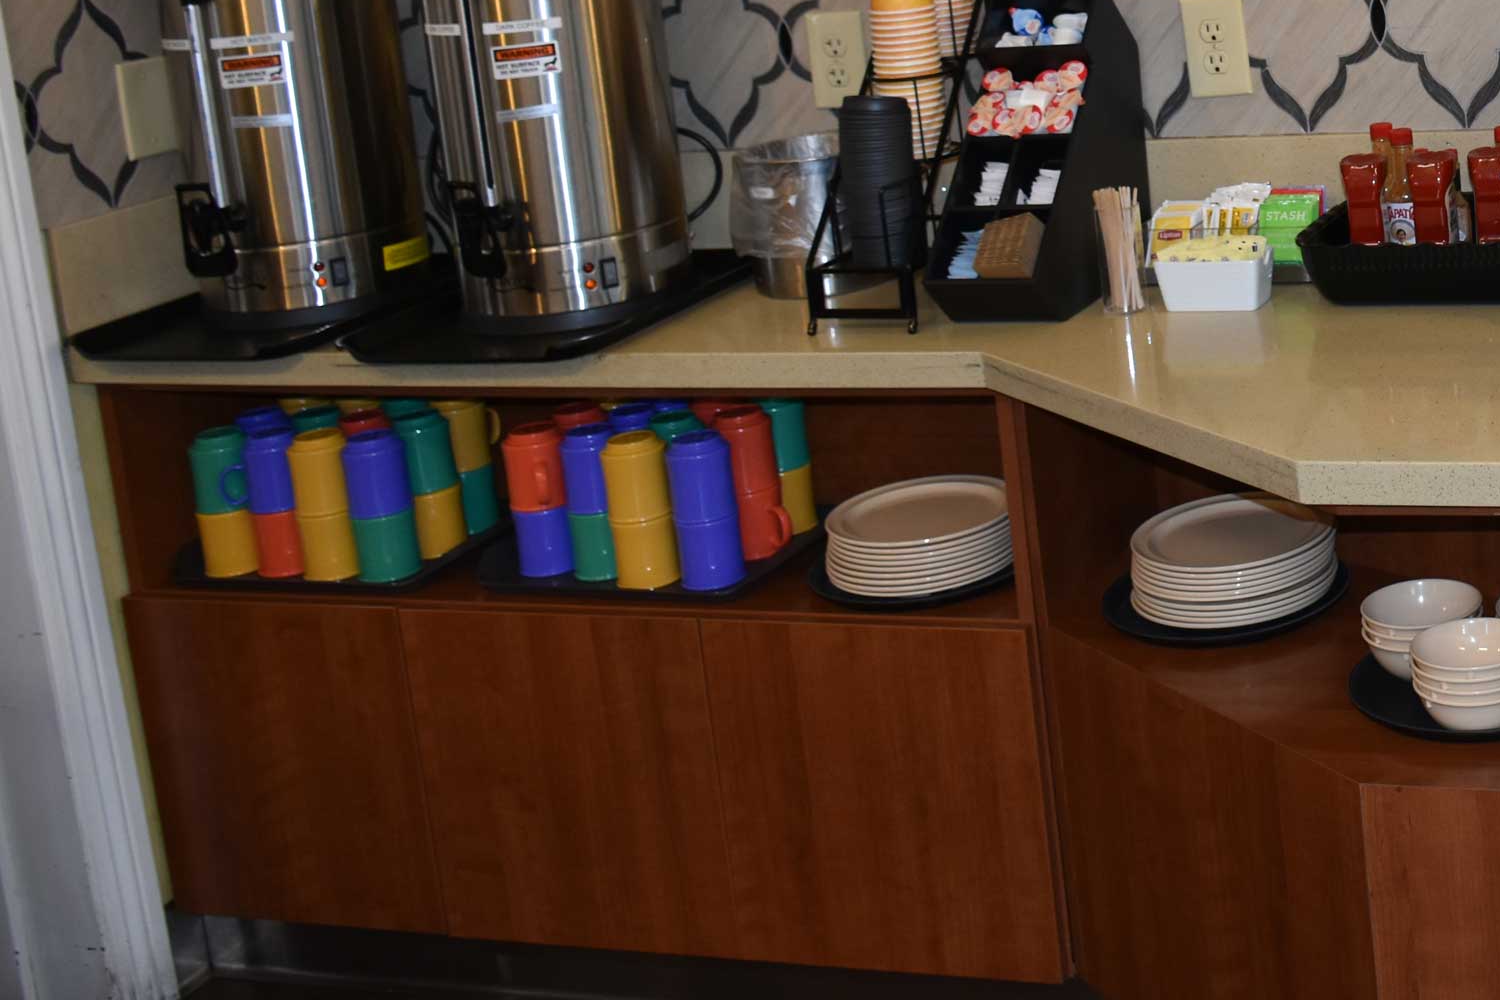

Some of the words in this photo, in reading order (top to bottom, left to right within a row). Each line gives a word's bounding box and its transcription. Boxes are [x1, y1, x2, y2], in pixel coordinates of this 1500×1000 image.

[501, 47, 549, 59] WARNING
[228, 57, 273, 69] WARNING
[1265, 210, 1306, 221] STASH
